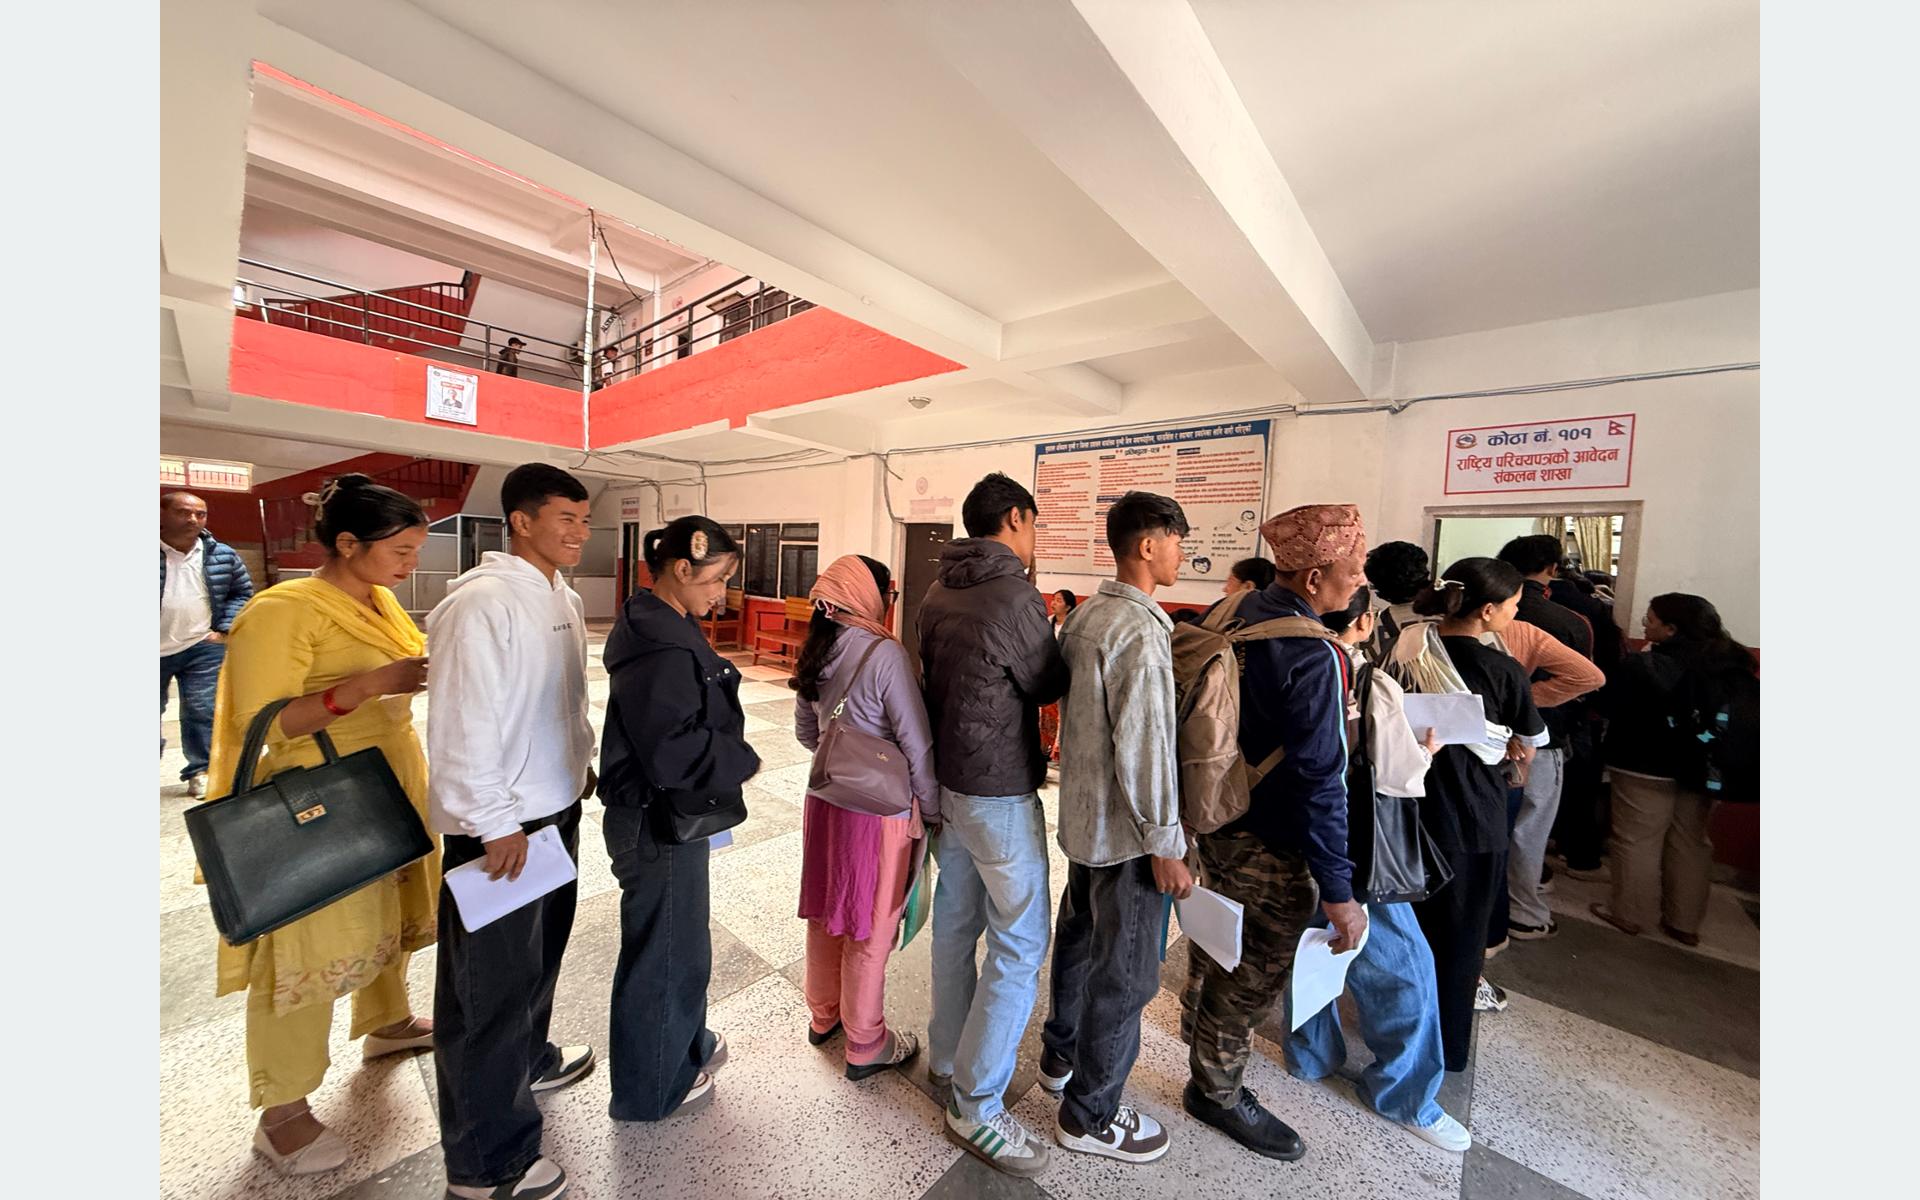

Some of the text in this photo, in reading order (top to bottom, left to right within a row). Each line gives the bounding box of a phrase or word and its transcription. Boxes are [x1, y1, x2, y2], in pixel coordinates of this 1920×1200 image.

[1487, 427, 1592, 447] कोठा नं. १०१
[1456, 446, 1620, 472] राष्ट्रिय परिचयपत्रको आवेदन
[1493, 467, 1572, 484] संकलन शाखा
